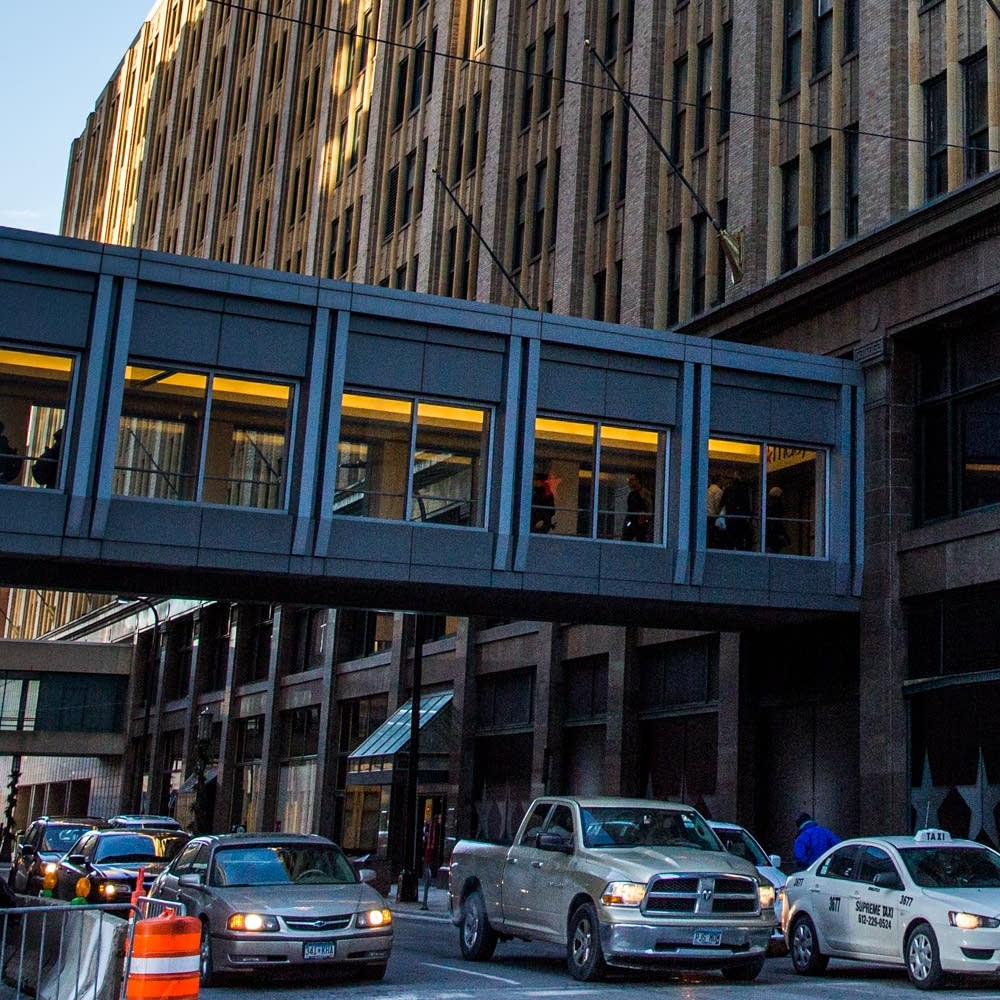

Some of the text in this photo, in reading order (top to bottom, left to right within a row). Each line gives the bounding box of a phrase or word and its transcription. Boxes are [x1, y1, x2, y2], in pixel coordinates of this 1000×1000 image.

[926, 832, 945, 841] TAXI
[829, 896, 841, 912] 3677
[899, 895, 914, 907] 3677
[855, 900, 894, 919] SUPREME TAXI
